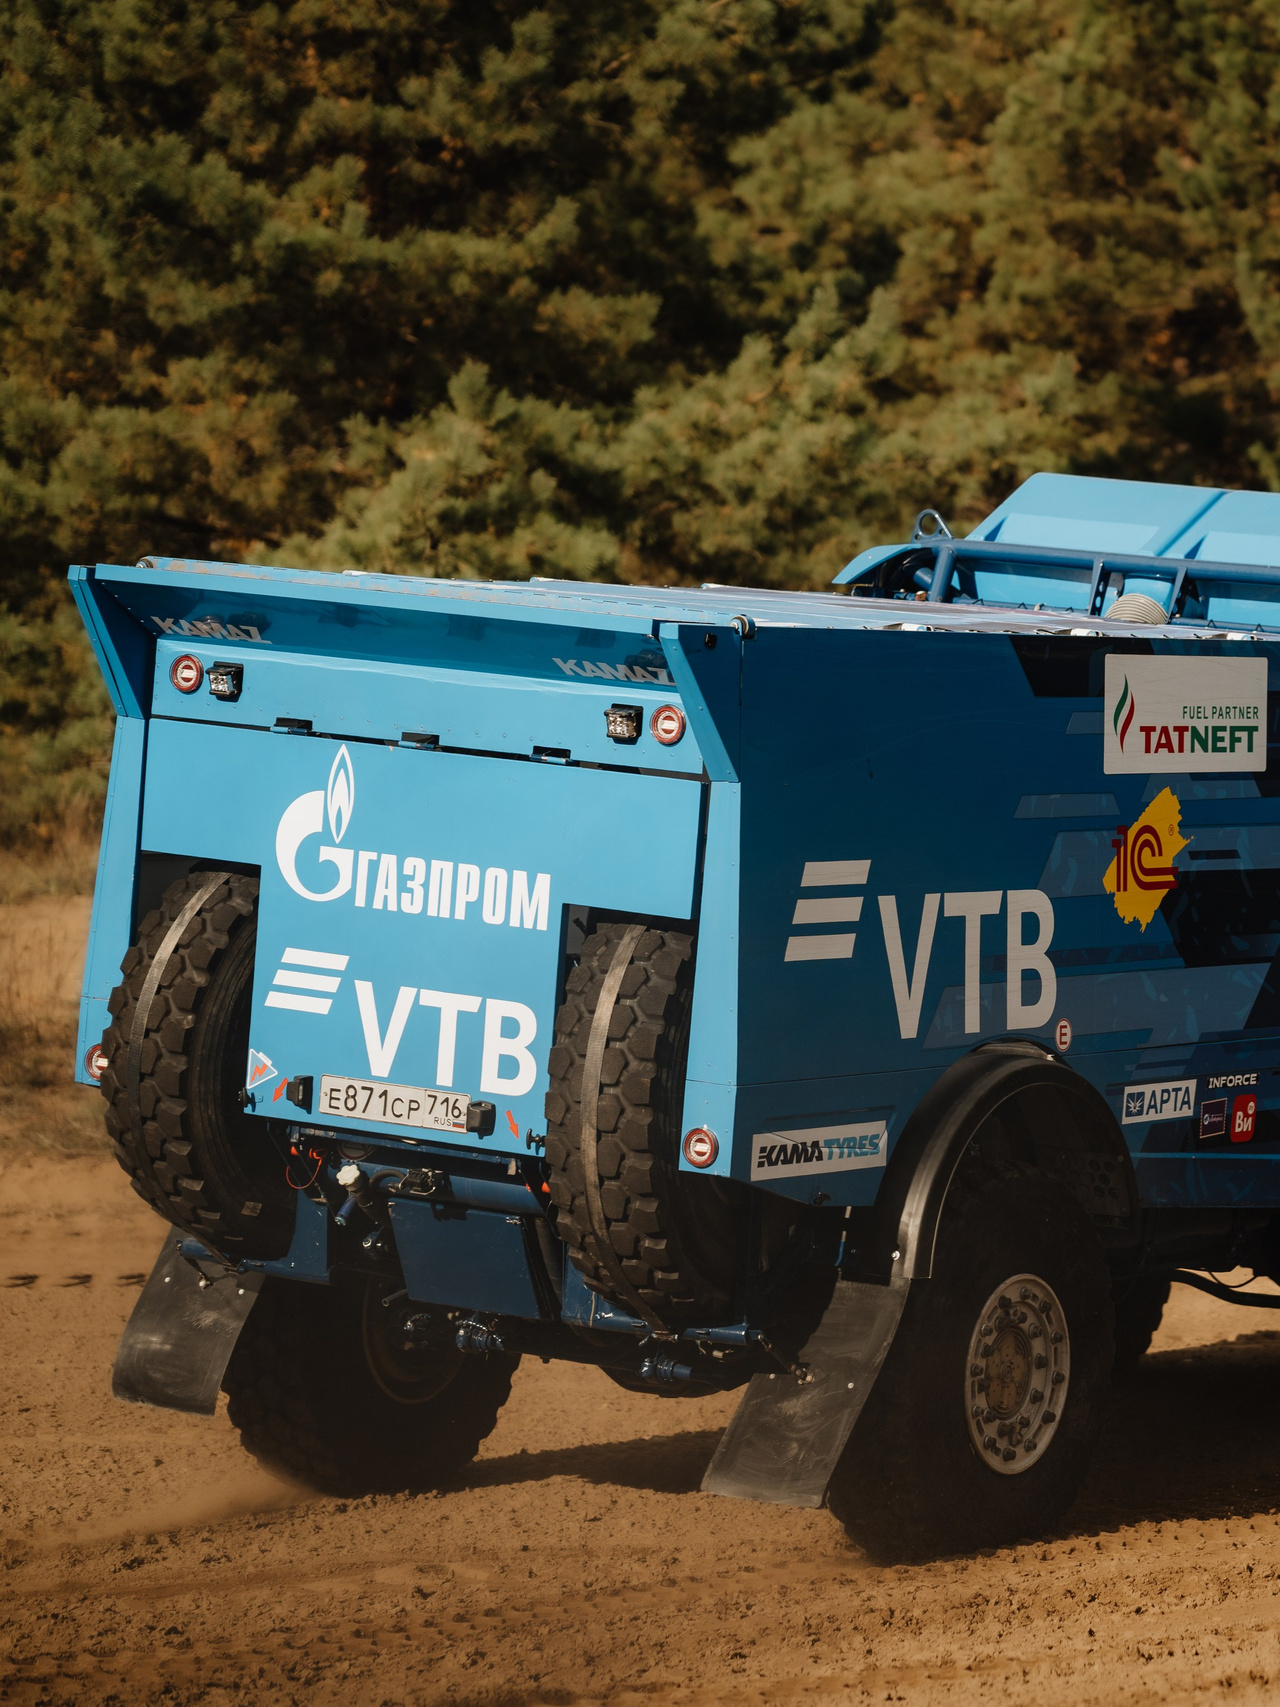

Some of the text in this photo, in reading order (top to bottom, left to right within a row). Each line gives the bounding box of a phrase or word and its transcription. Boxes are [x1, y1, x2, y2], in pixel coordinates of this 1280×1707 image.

[150, 616, 273, 645] KAMAZ
[552, 657, 677, 687] KAMAZ
[1182, 705, 1259, 720] FUEL PARTNER
[1139, 725, 1259, 754] TATNEFT
[354, 850, 551, 931] ГАЗПРОМ
[877, 889, 1057, 1039] VTB
[354, 979, 538, 1097] VTB
[1208, 1073, 1258, 1089] INFORCE
[427, 1094, 462, 1119] 716
[433, 1116, 452, 1127] RUS
